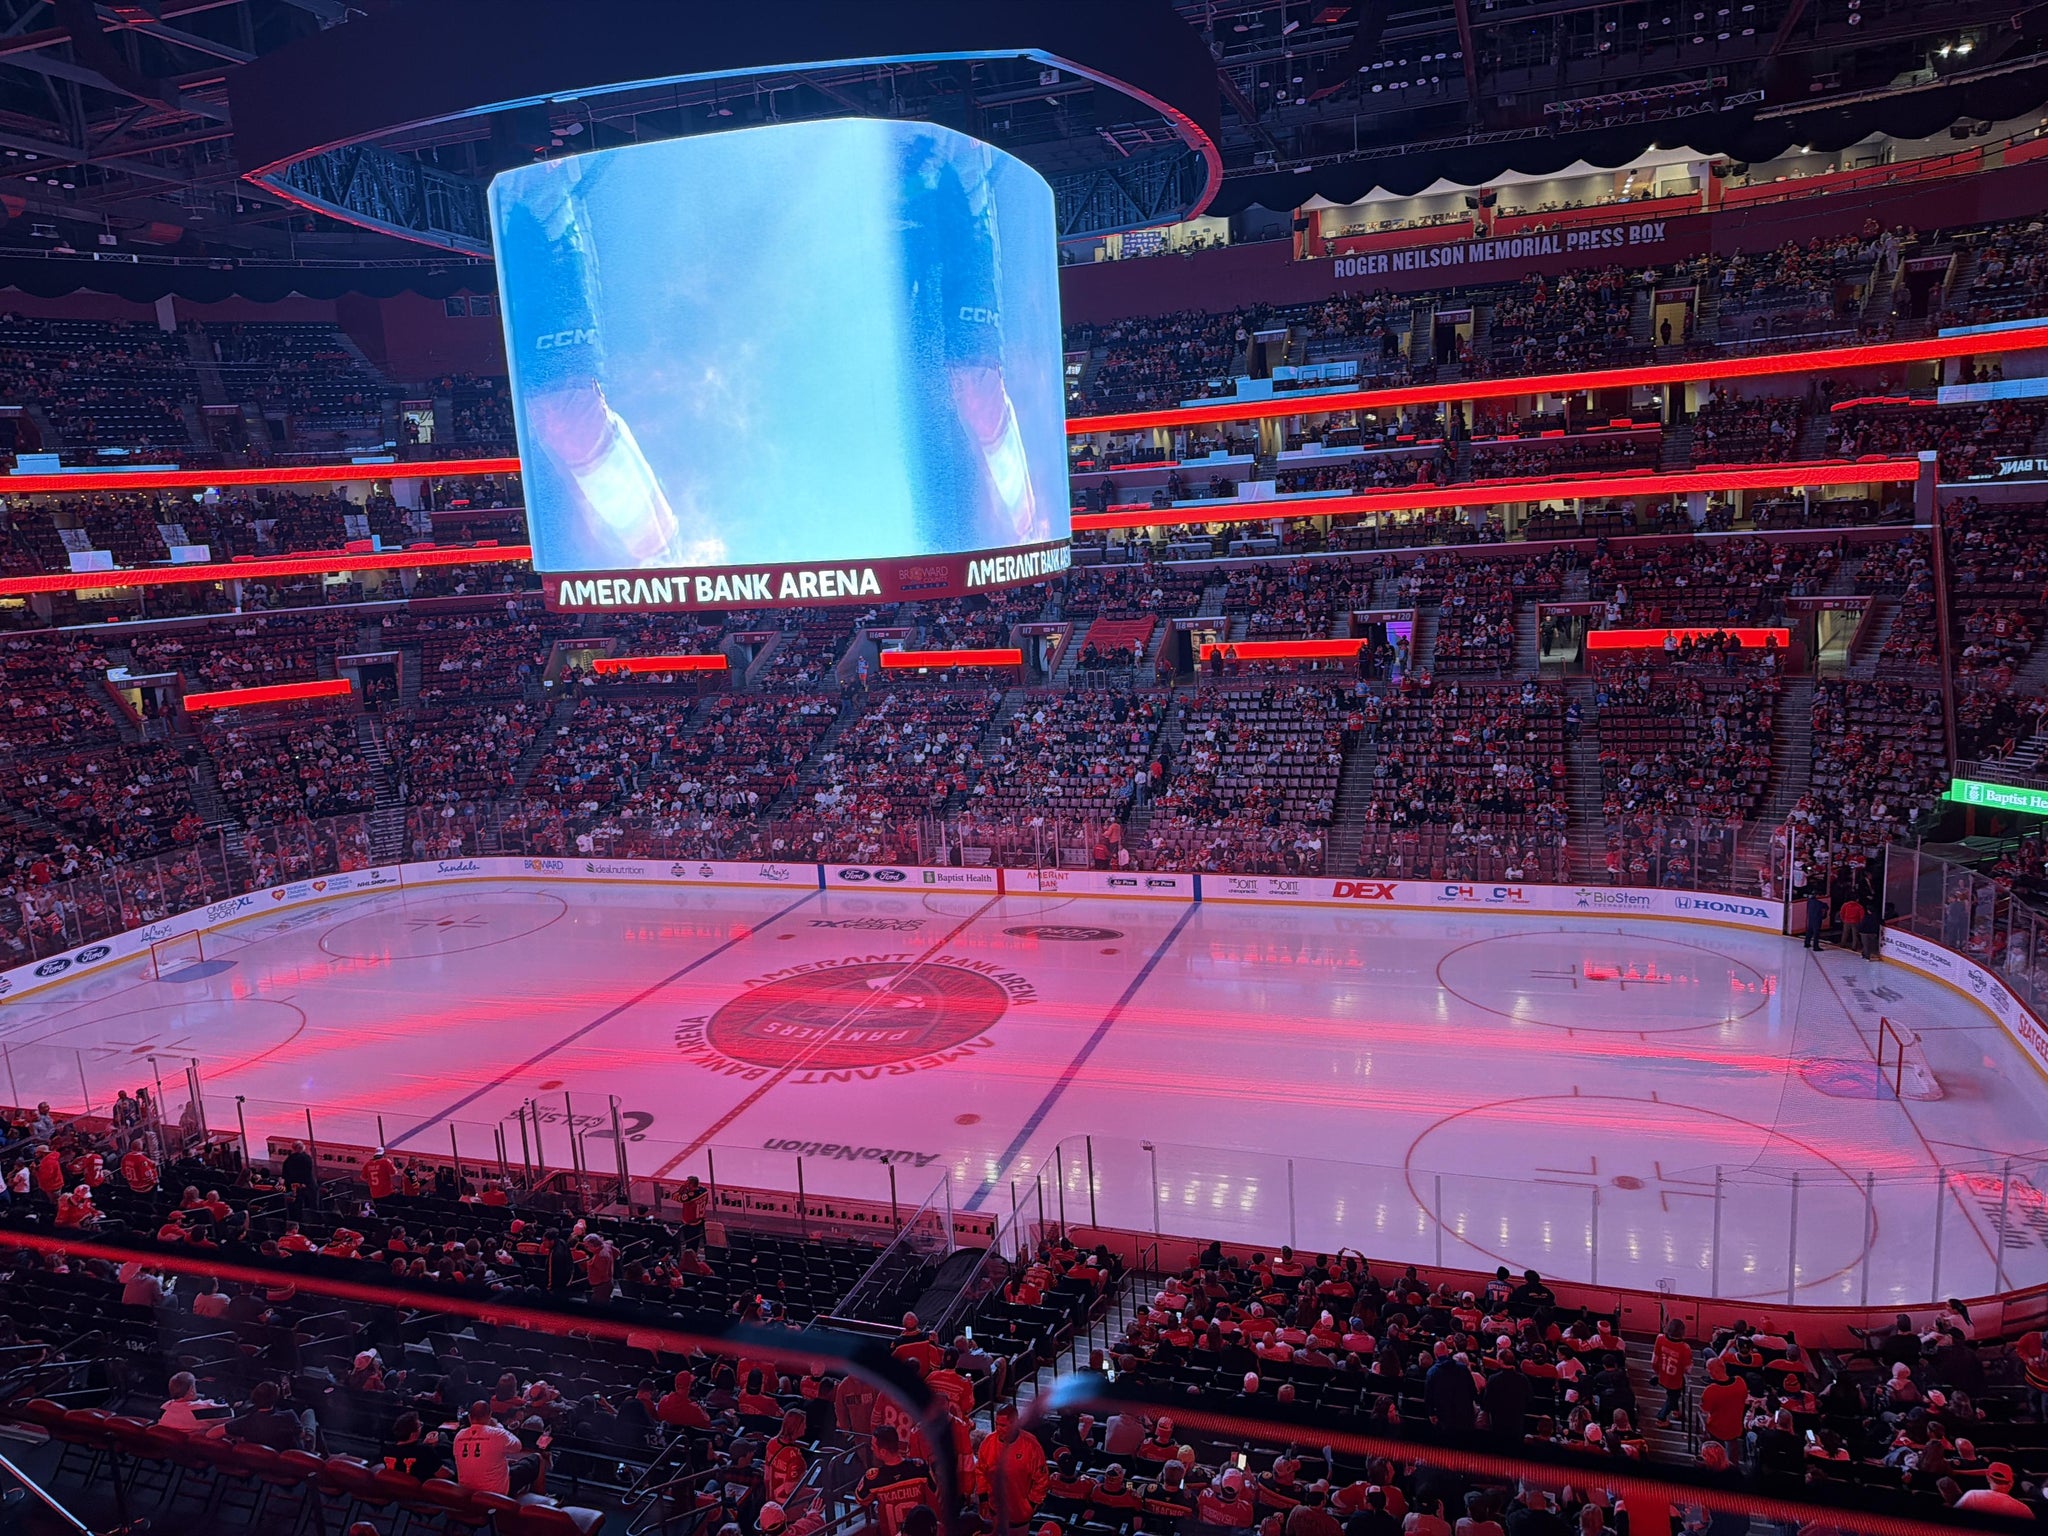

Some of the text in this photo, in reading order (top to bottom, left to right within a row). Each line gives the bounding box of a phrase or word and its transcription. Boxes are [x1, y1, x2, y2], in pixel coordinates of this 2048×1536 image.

[1334, 222, 1666, 279] ROGER NEILSON MEMORIAL PRESS BOX
[959, 306, 999, 328] CCM
[536, 329, 597, 350] CCM
[967, 551, 1040, 587] AMERANT
[559, 568, 882, 606] AMERANT BANK ARENA
[1844, 601, 1860, 609] 122
[1213, 619, 1225, 628] 119
[1357, 612, 1411, 622] 119 120
[1986, 789, 2028, 806] Baptist
[438, 861, 480, 873] Sandals
[843, 870, 865, 880] Ford
[879, 870, 900, 881] Ford
[937, 873, 992, 883] Baptist Health
[1332, 881, 1398, 900] DEX
[1445, 886, 1473, 897] CH
[1493, 887, 1522, 899] CH
[1593, 892, 1650, 905] BioStem
[207, 897, 254, 914] OMEGA XL
[1693, 899, 1769, 919] HONDA
[208, 907, 236, 922] SPORT
[82, 947, 105, 962] Ford
[1895, 940, 1920, 953] CENTERS
[41, 960, 66, 976] Ford
[743, 953, 1039, 1006] AMERANT BANK ARENA
[764, 1022, 909, 1042] PANTHERS
[674, 1015, 995, 1084] AMERANT BANK ARENA
[764, 1138, 941, 1168] AutoNation
[370, 1171, 379, 1186] 5
[877, 1485, 921, 1501] TKACHUK
